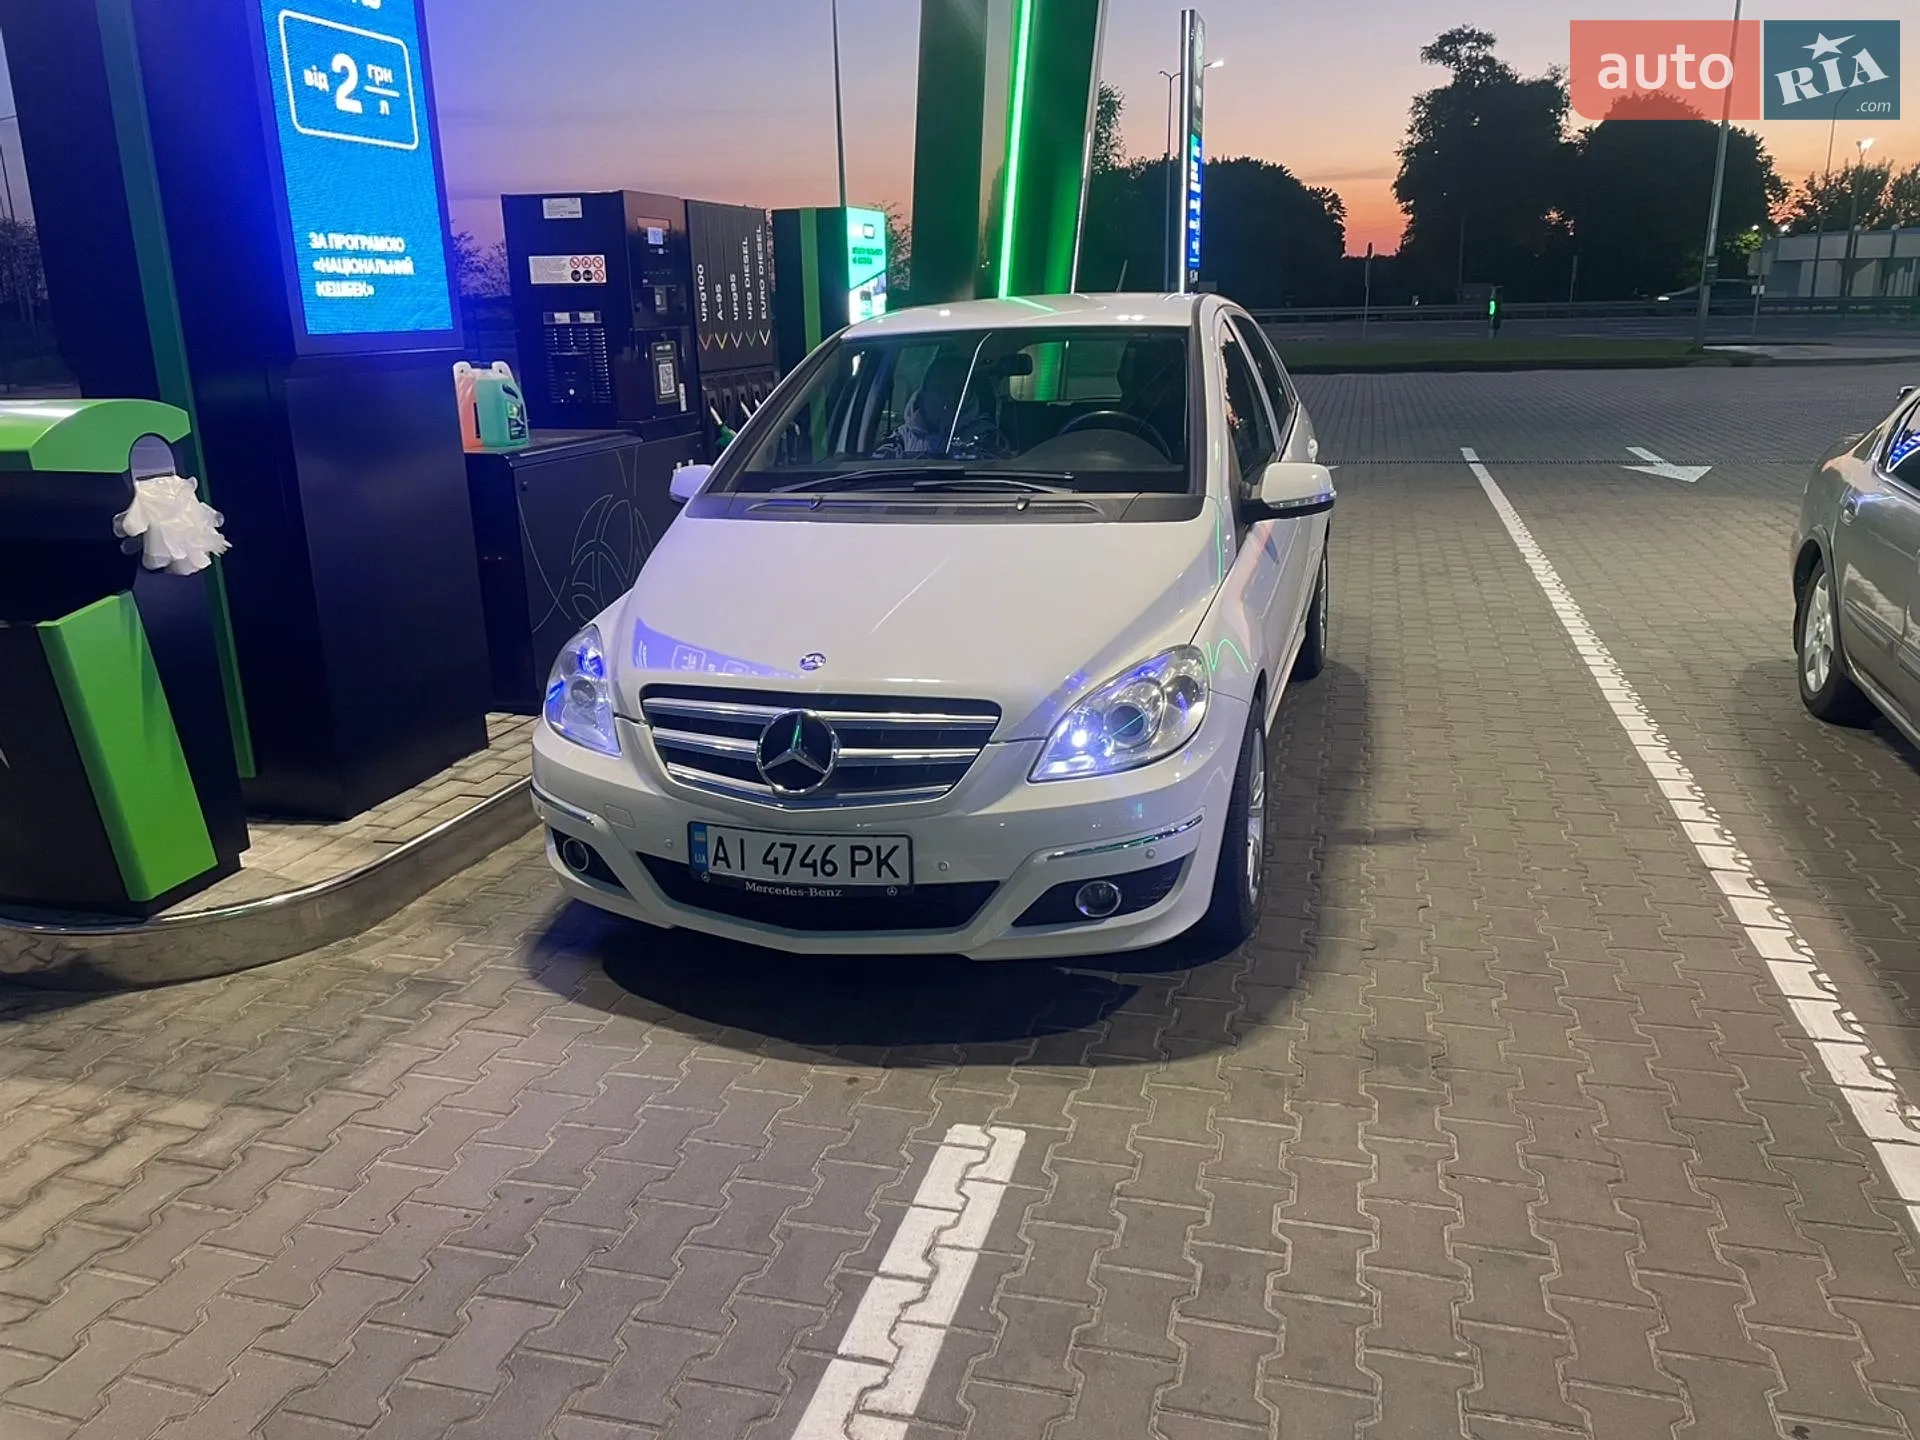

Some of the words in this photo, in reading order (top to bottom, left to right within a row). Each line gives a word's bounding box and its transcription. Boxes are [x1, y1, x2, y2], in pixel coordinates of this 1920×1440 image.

[303, 65, 329, 92] від
[331, 53, 363, 114] 2
[366, 63, 393, 86] грн
[308, 231, 328, 249] ЗА
[328, 232, 406, 253] ПРОГРАМОЮ
[742, 236, 750, 288] DIESEL
[756, 224, 764, 275] DIESEL
[712, 836, 745, 871] AI
[762, 841, 839, 877] 4746
[850, 844, 900, 879] PK
[745, 882, 842, 897] Mercedes-Benz
